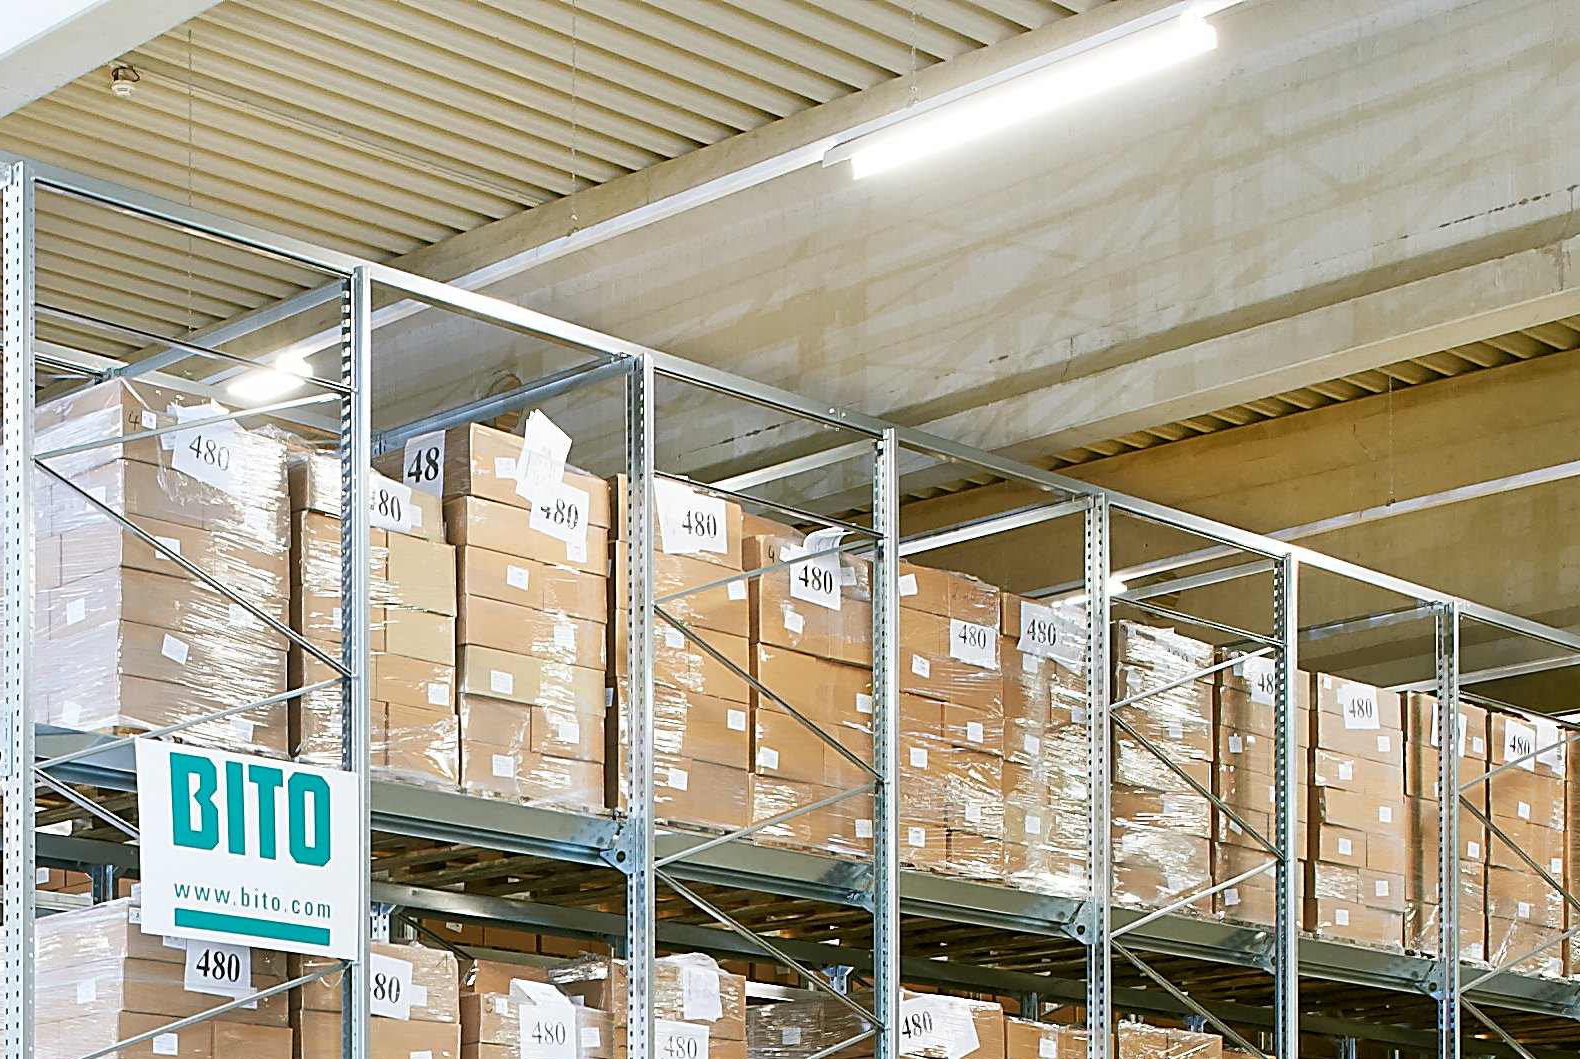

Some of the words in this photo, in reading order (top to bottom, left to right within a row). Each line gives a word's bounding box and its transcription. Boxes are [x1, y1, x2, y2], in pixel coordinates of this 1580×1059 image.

[189, 434, 230, 471] 480
[407, 446, 440, 484] 48
[370, 488, 401, 522] 80
[541, 498, 578, 530] 480
[682, 510, 717, 538] 480
[798, 564, 833, 594] 480
[959, 624, 987, 650] 480
[1026, 618, 1057, 646] 480
[1348, 697, 1373, 719] 480
[1509, 734, 1530, 756] 480
[169, 751, 332, 867] BITO
[173, 882, 331, 919] www.bito.com
[195, 948, 240, 983] 480
[371, 972, 401, 1004] 80
[531, 1021, 566, 1046] 480
[901, 1010, 933, 1039] 480
[663, 1035, 697, 1059] 480
